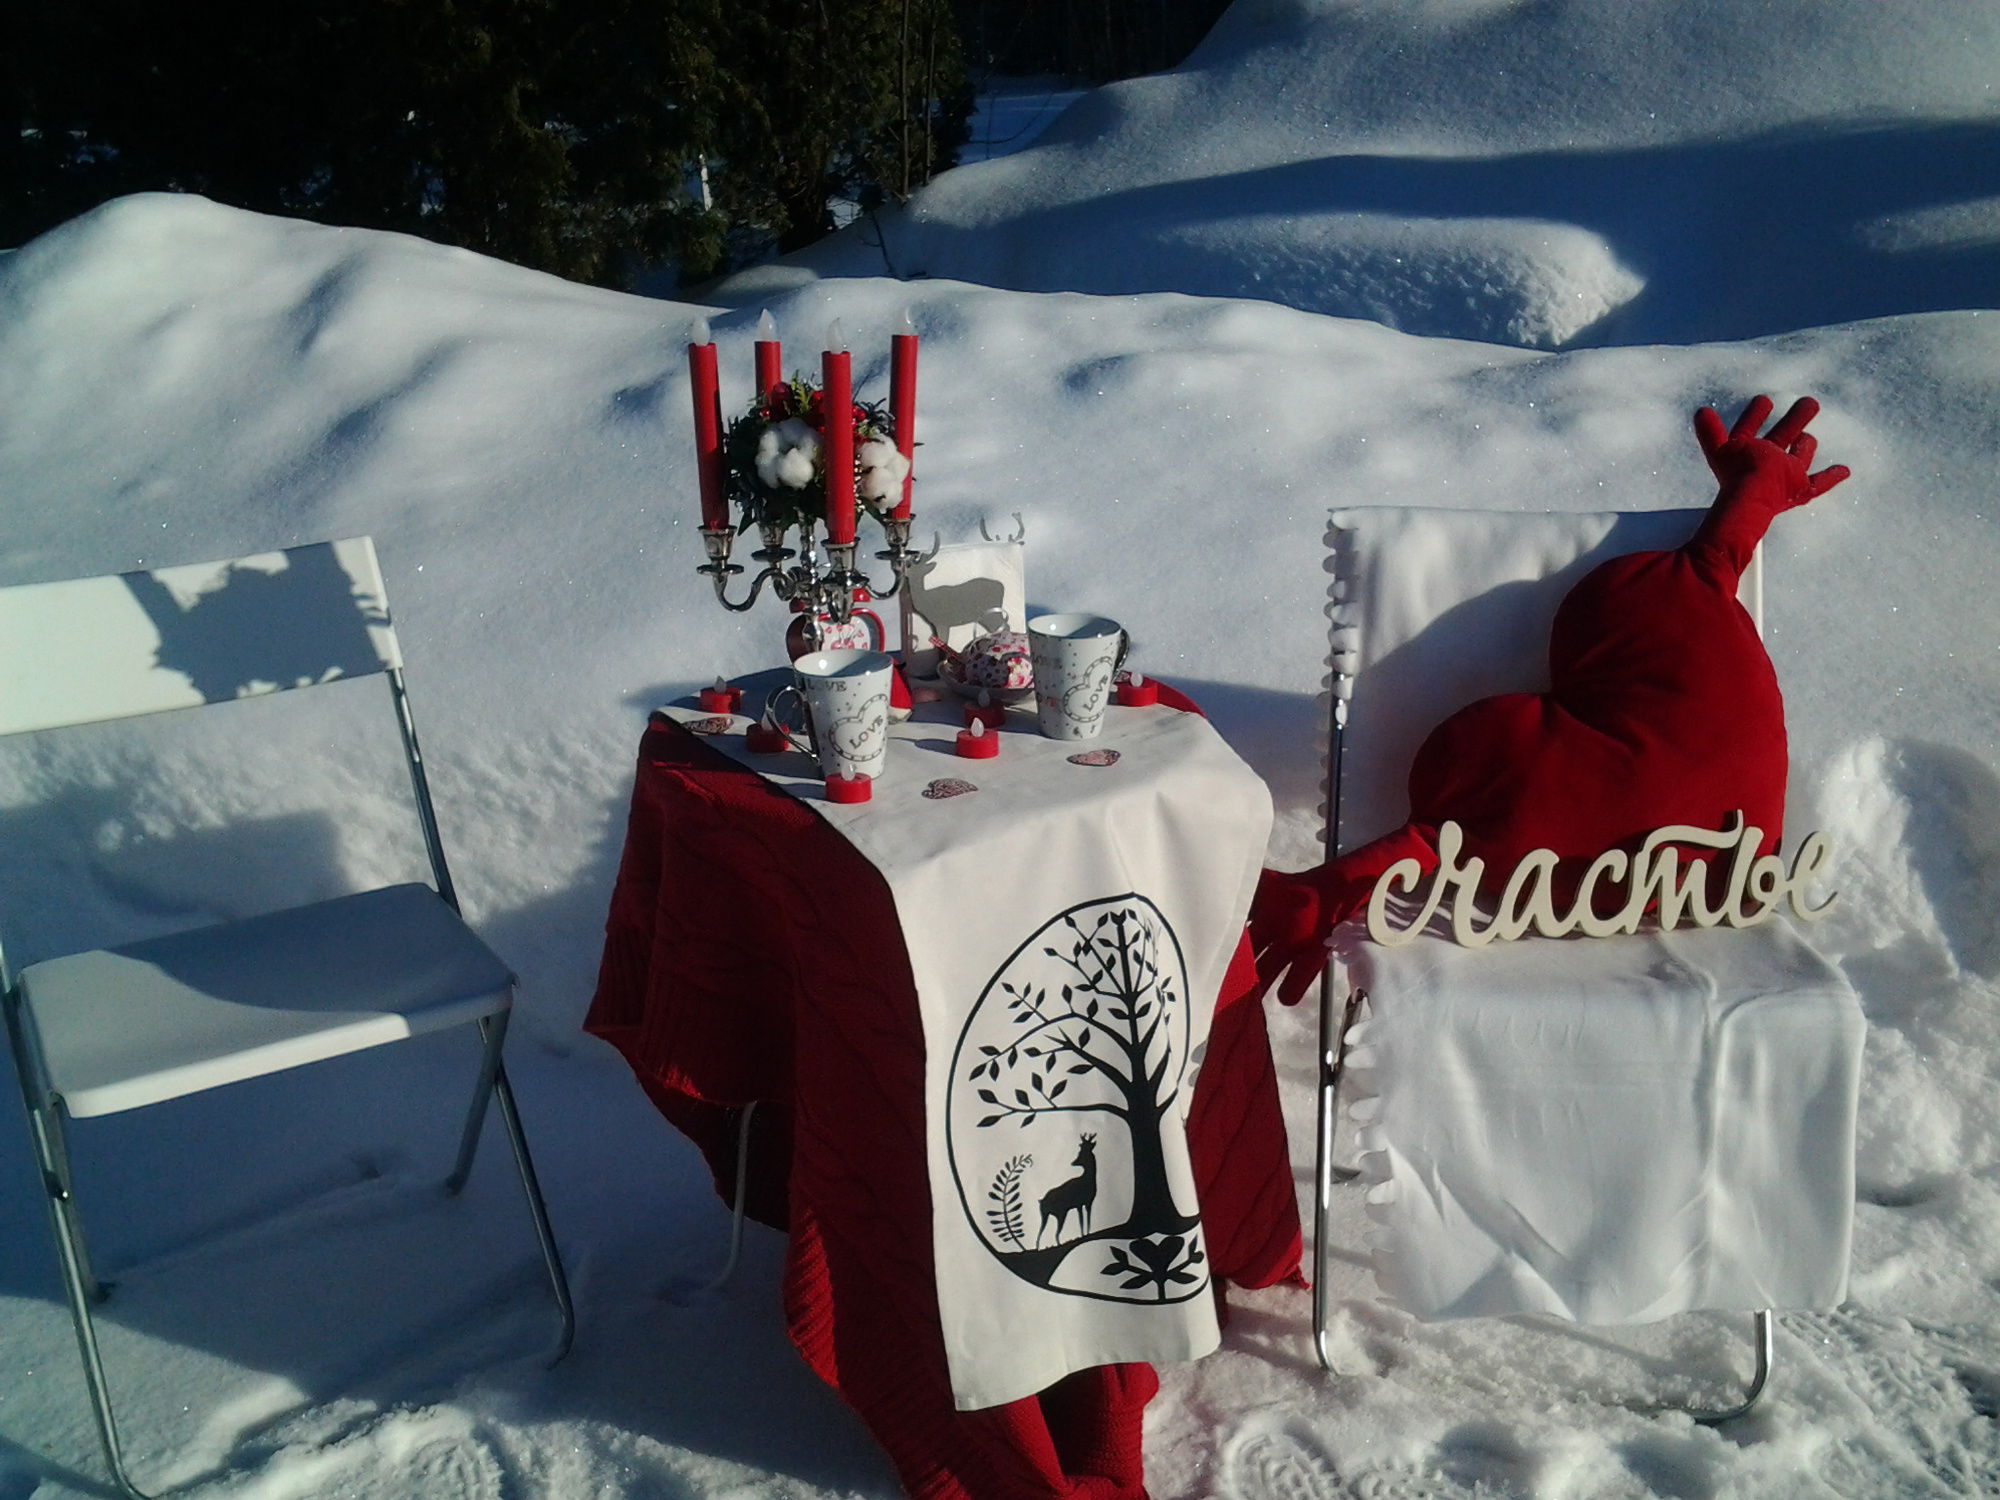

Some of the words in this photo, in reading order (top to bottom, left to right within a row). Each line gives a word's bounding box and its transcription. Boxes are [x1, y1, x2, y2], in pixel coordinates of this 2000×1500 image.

[1083, 674, 1109, 712] LOVE
[848, 714, 884, 749] LOVE
[1366, 809, 1838, 948] счастье
